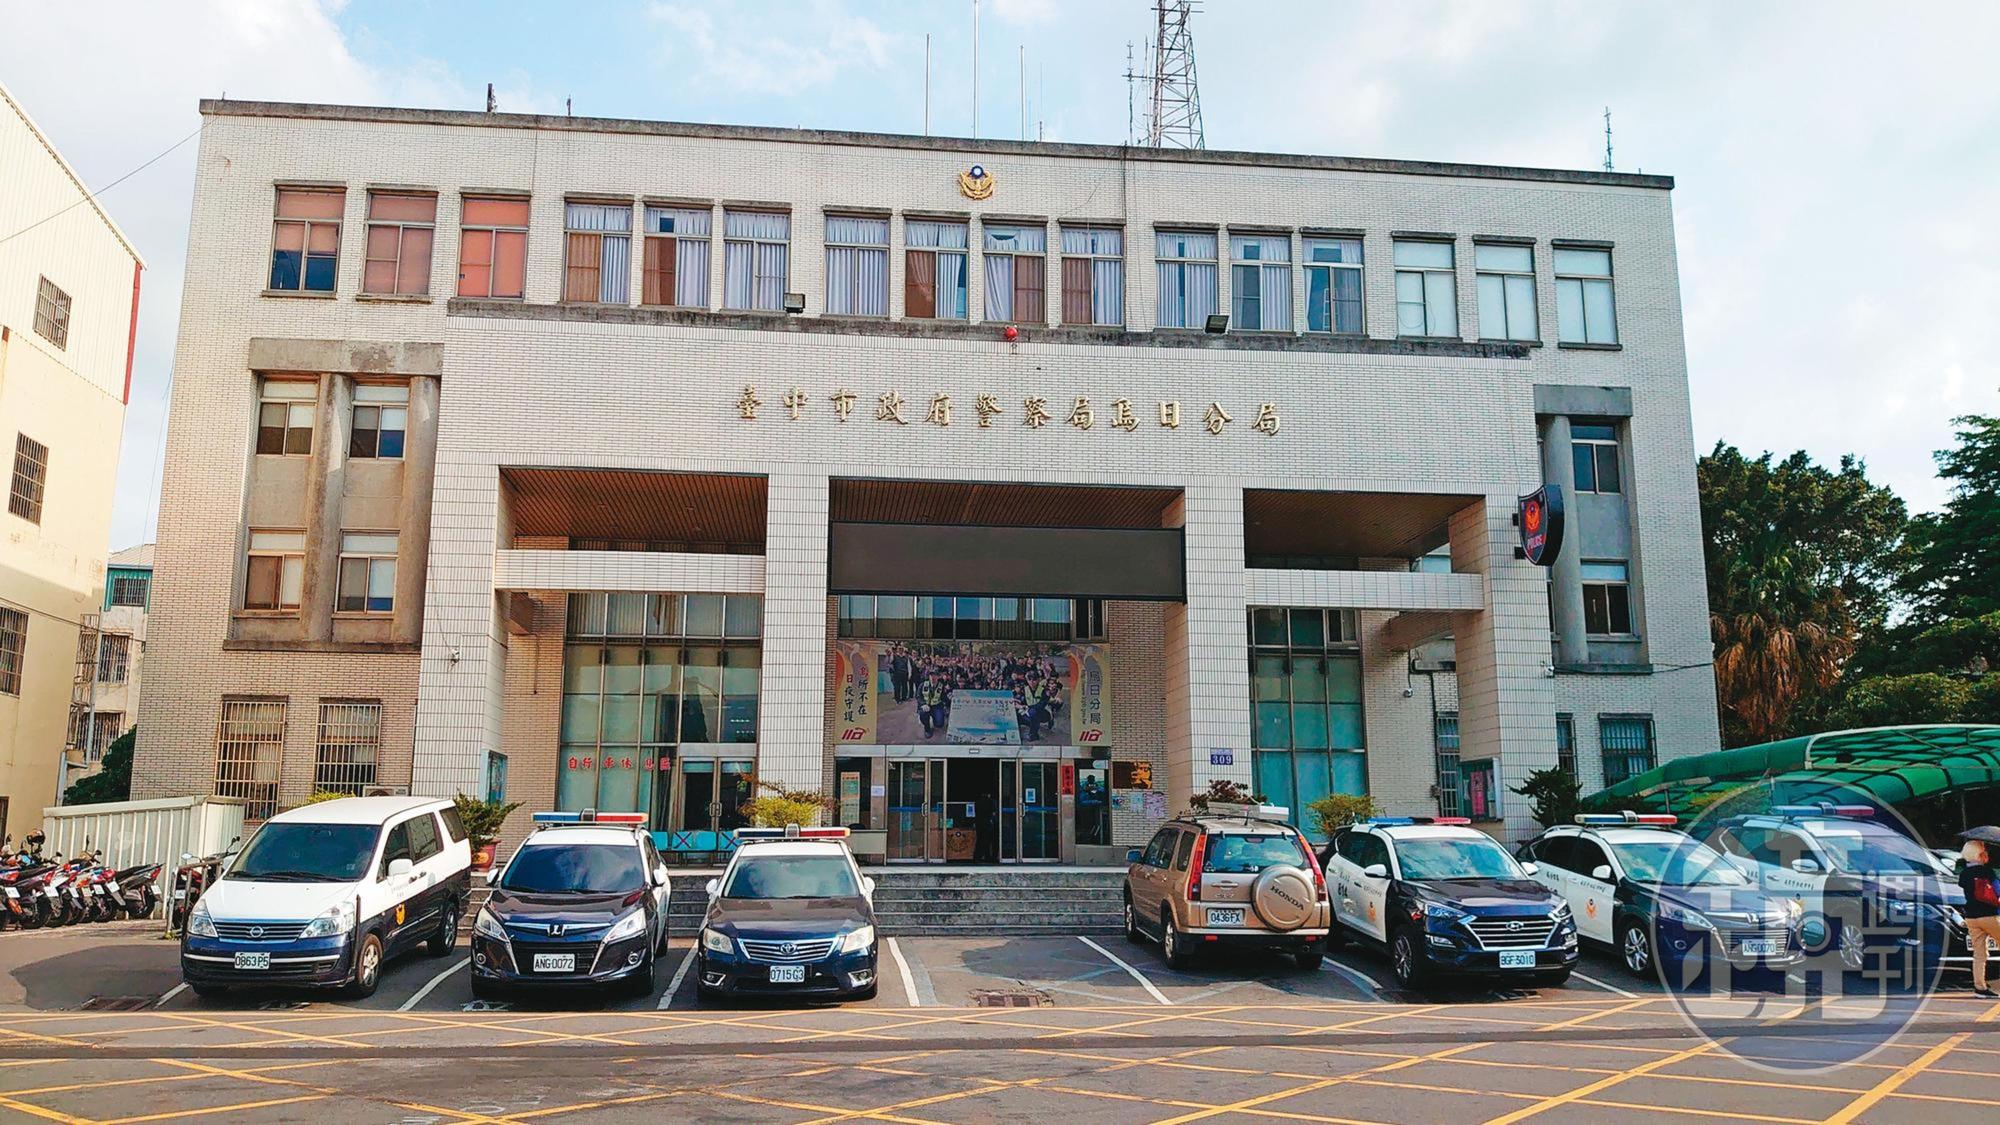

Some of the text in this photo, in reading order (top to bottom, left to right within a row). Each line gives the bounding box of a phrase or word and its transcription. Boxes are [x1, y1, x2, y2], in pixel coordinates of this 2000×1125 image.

[736, 383, 1281, 436] 臺中市政府警察局烏日分局
[1270, 886, 1304, 911] HONDA
